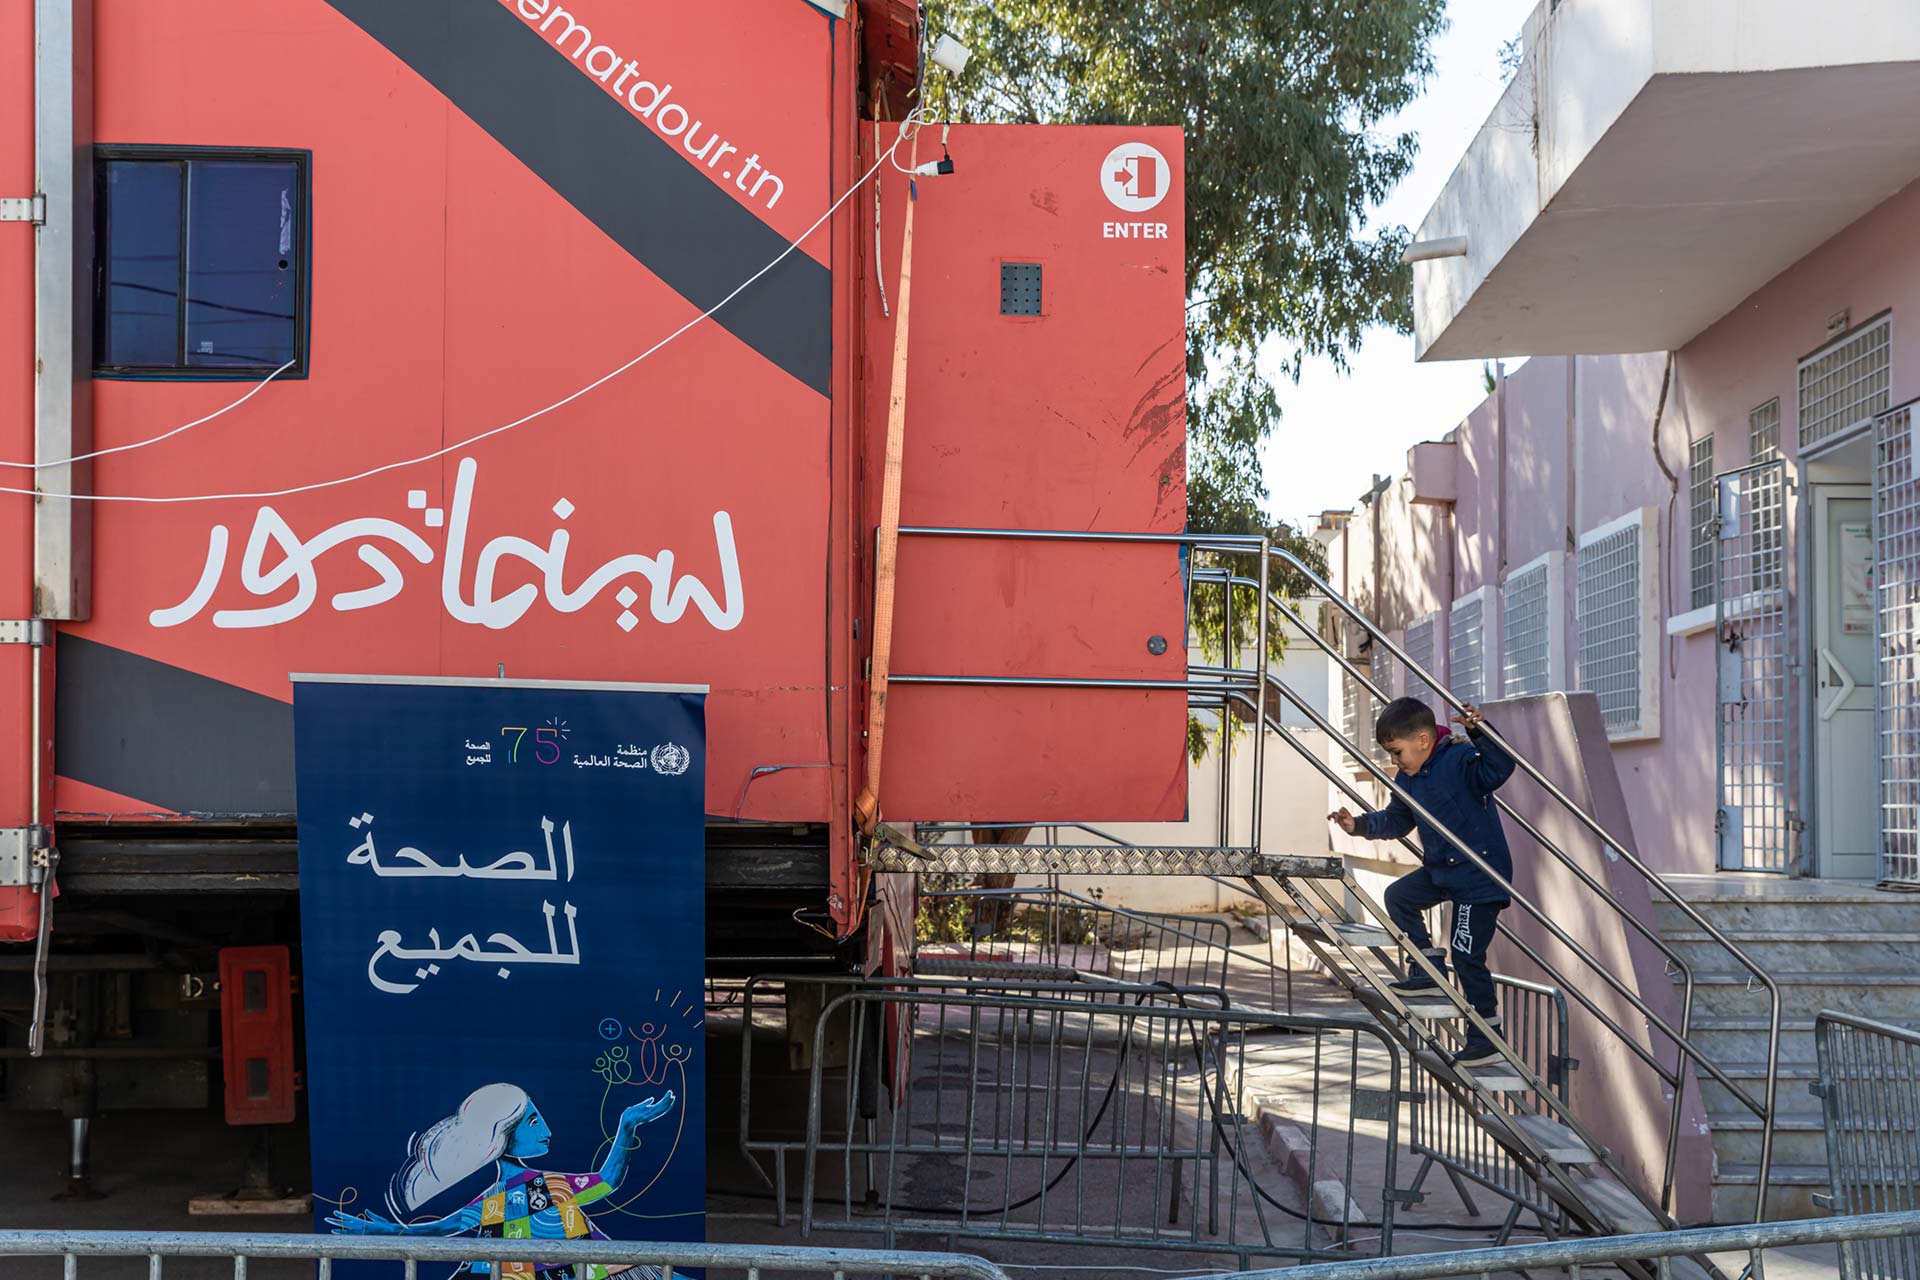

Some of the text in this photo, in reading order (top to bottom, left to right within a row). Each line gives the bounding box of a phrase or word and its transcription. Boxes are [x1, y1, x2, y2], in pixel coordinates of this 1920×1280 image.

[507, 0, 785, 210] ematdour.tn
[1103, 222, 1168, 239] ENTER
[464, 738, 491, 750] الصحة
[501, 727, 561, 765] 75
[616, 744, 648, 756] منظمة
[465, 753, 492, 766] للجميع
[573, 754, 648, 769] الصحة العالمية
[346, 812, 575, 883] الصحة
[368, 899, 581, 994] للجميع
